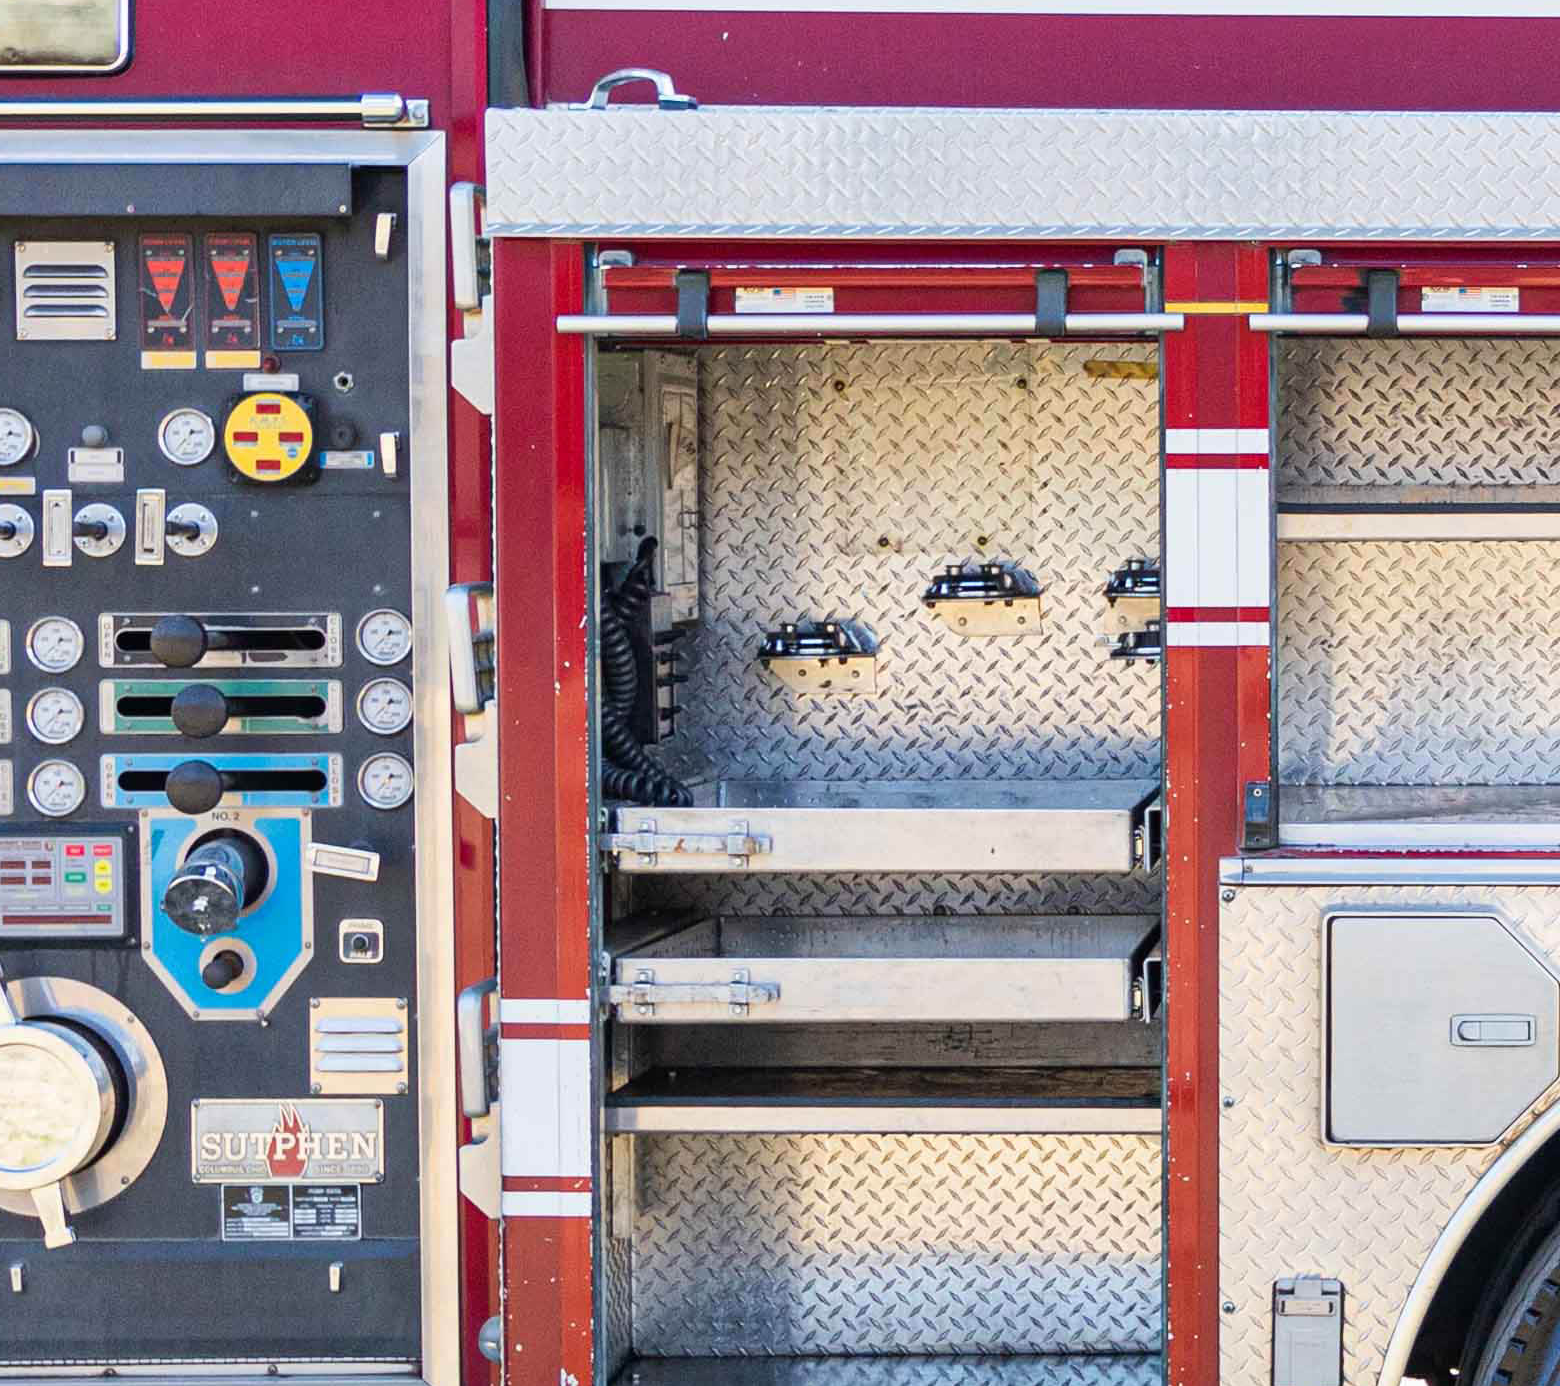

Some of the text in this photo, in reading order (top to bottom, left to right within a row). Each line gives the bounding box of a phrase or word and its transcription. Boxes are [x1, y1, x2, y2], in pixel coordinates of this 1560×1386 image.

[212, 812, 241, 822] NO. 2
[200, 1132, 377, 1161] SUTPHEN
